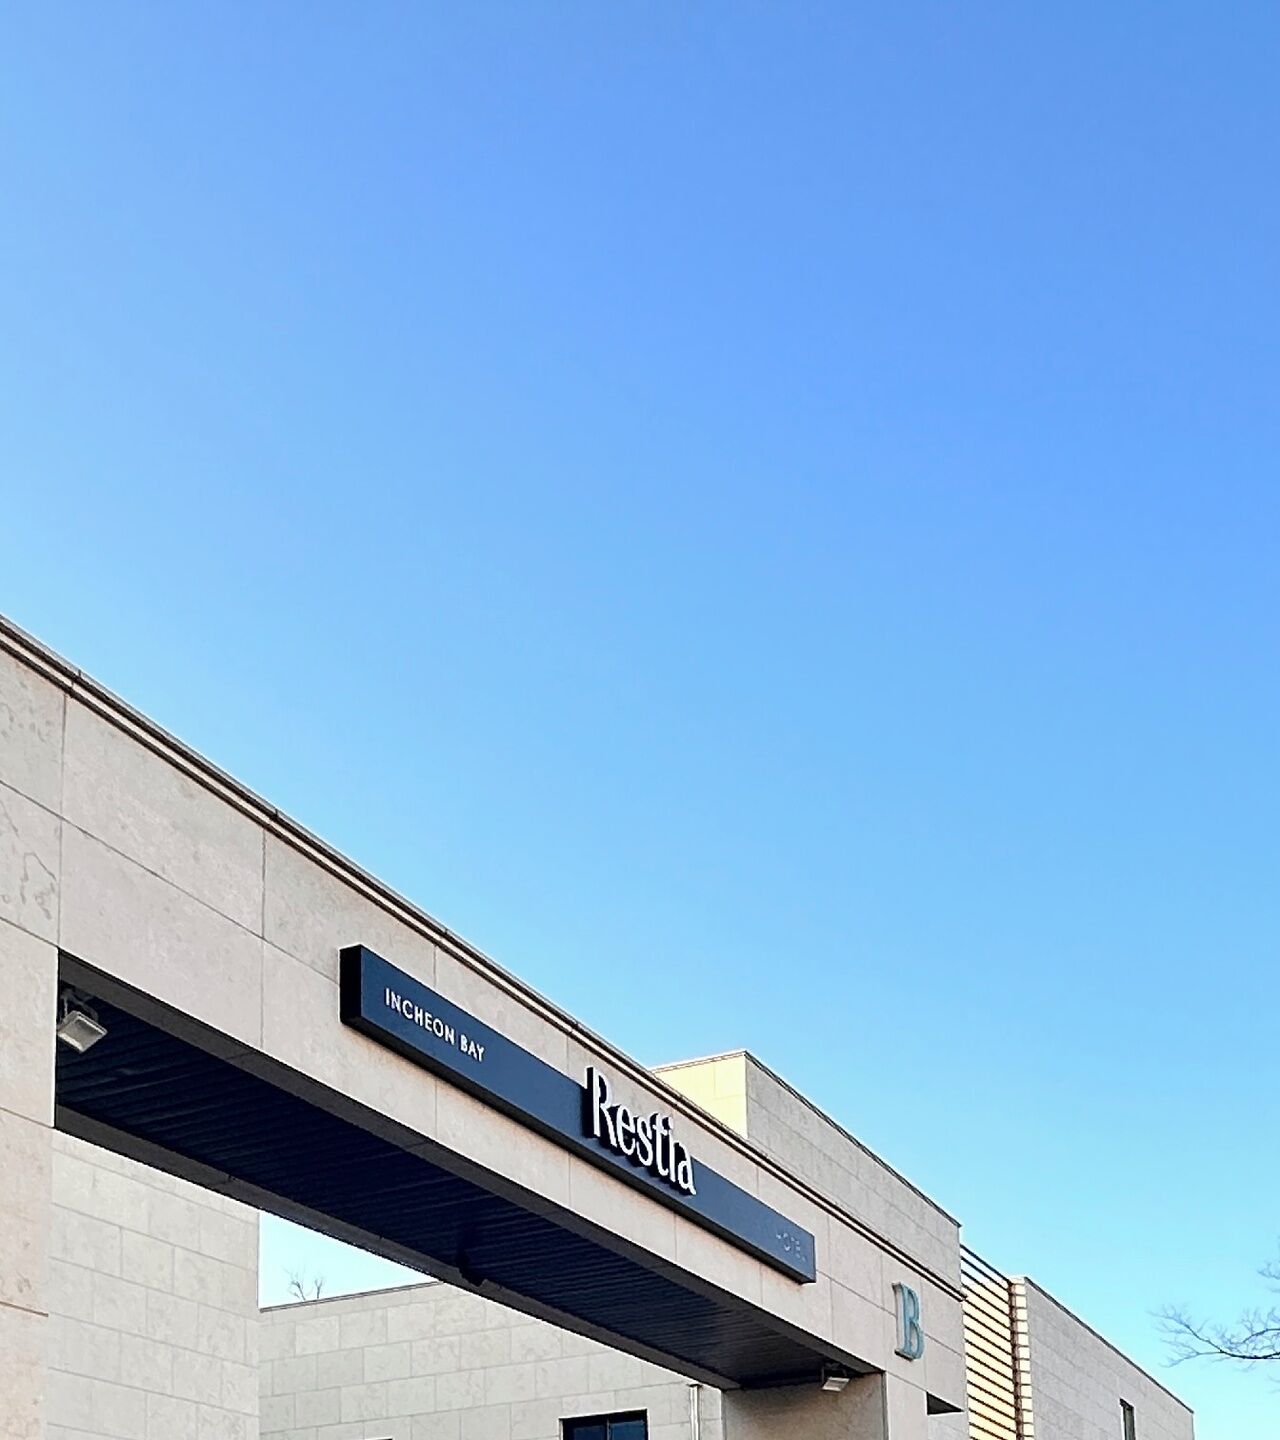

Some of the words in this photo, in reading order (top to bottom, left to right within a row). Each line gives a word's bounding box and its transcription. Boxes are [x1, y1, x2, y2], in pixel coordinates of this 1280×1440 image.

[385, 988, 455, 1046] INCHEON
[460, 1034, 484, 1062] BAY
[587, 1067, 696, 1195] Restia
[892, 1283, 924, 1360] B
